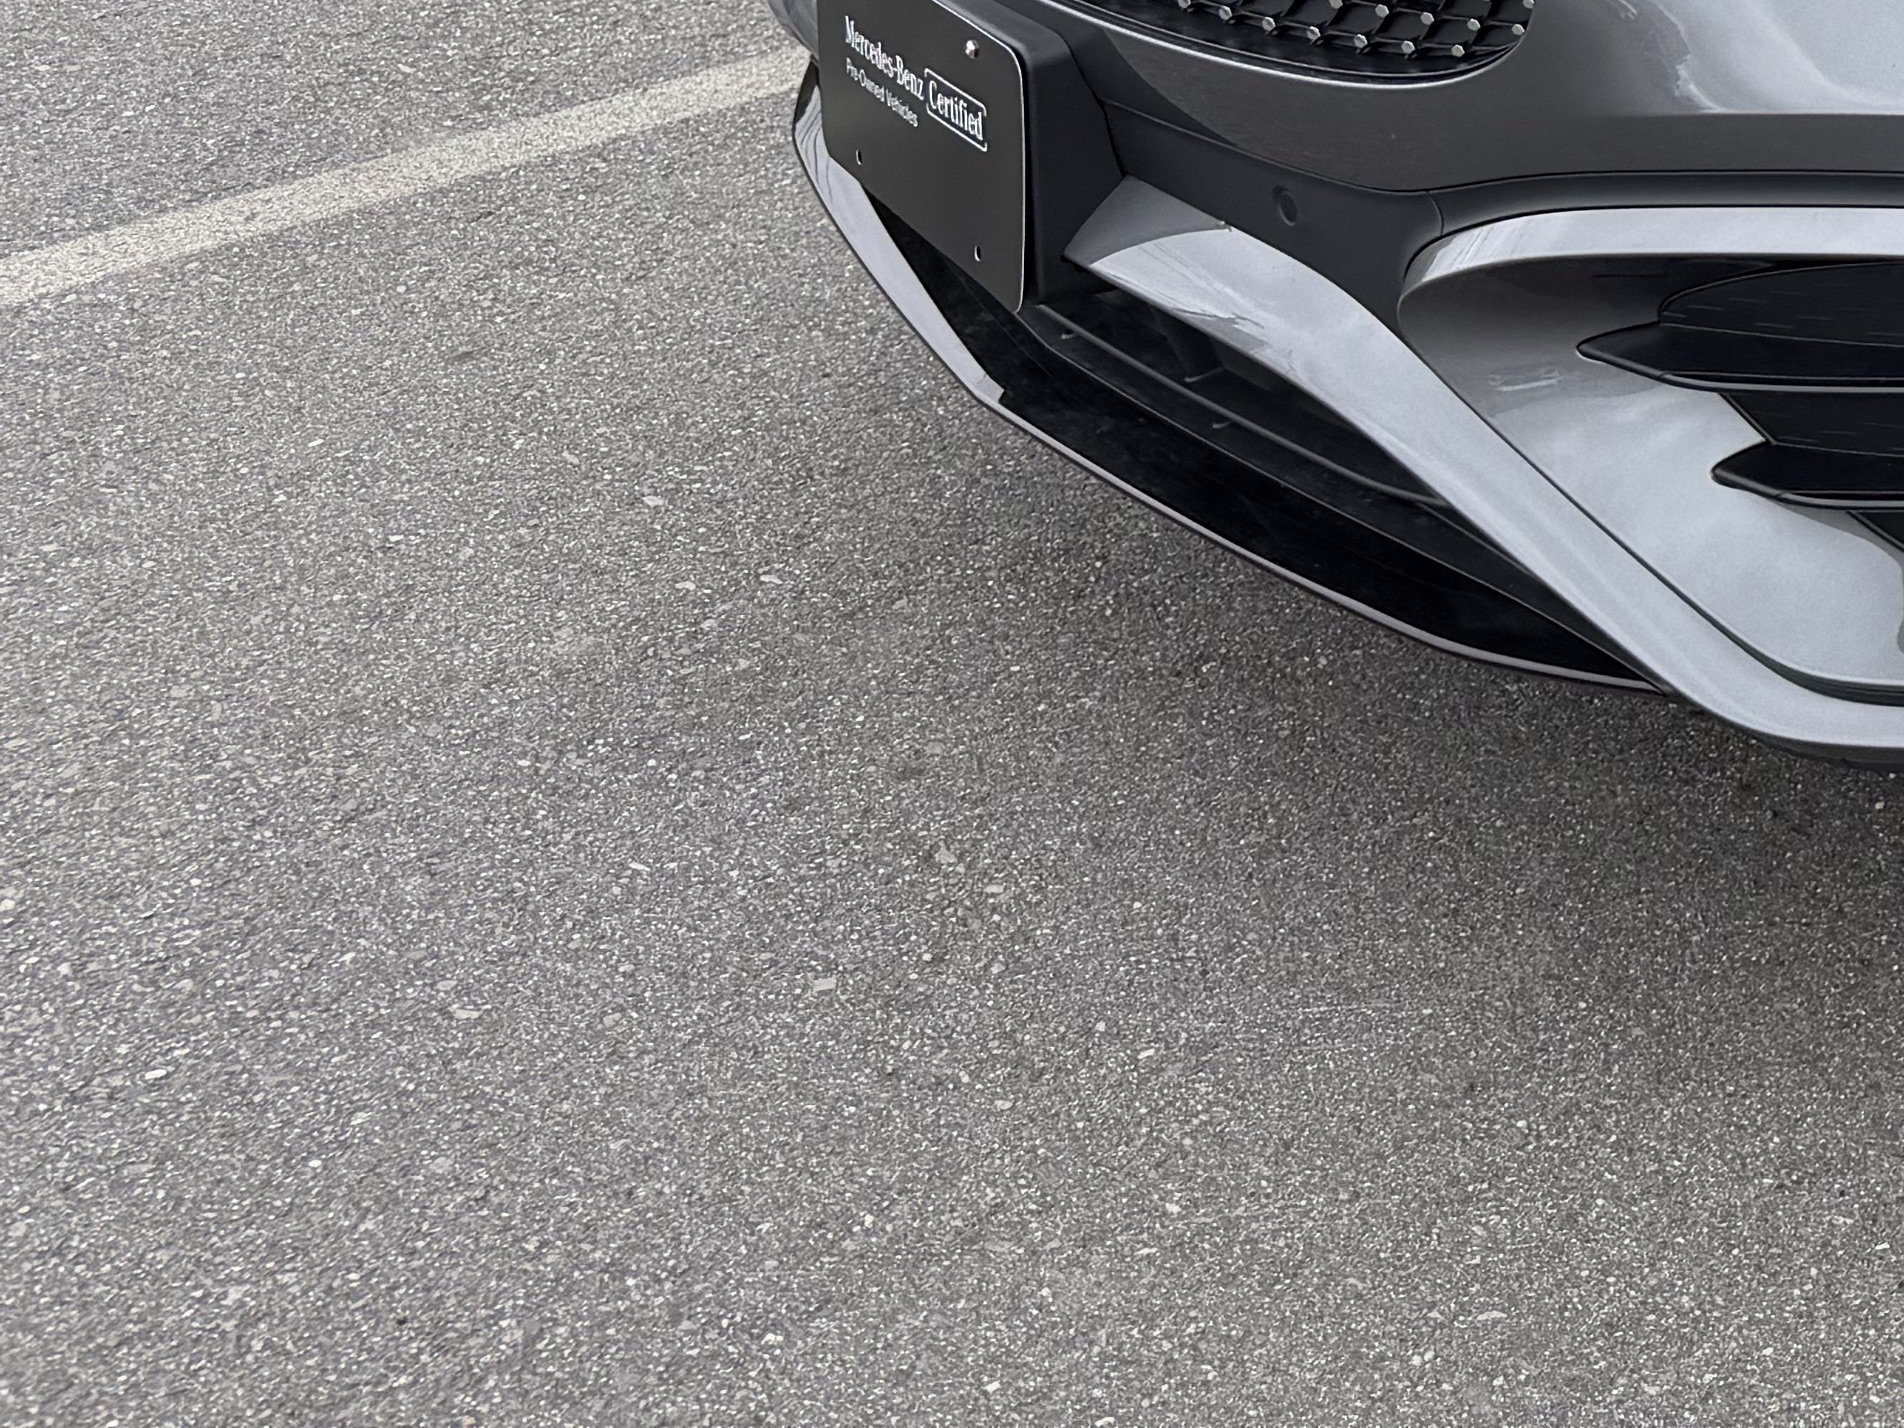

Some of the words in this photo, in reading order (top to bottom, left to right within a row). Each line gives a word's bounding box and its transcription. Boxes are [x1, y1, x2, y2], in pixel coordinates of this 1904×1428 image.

[844, 15, 924, 101] Mercedes-Benz
[929, 80, 983, 141] Certified
[845, 57, 885, 102] Pre-Owned
[885, 88, 919, 128] Vehicles
